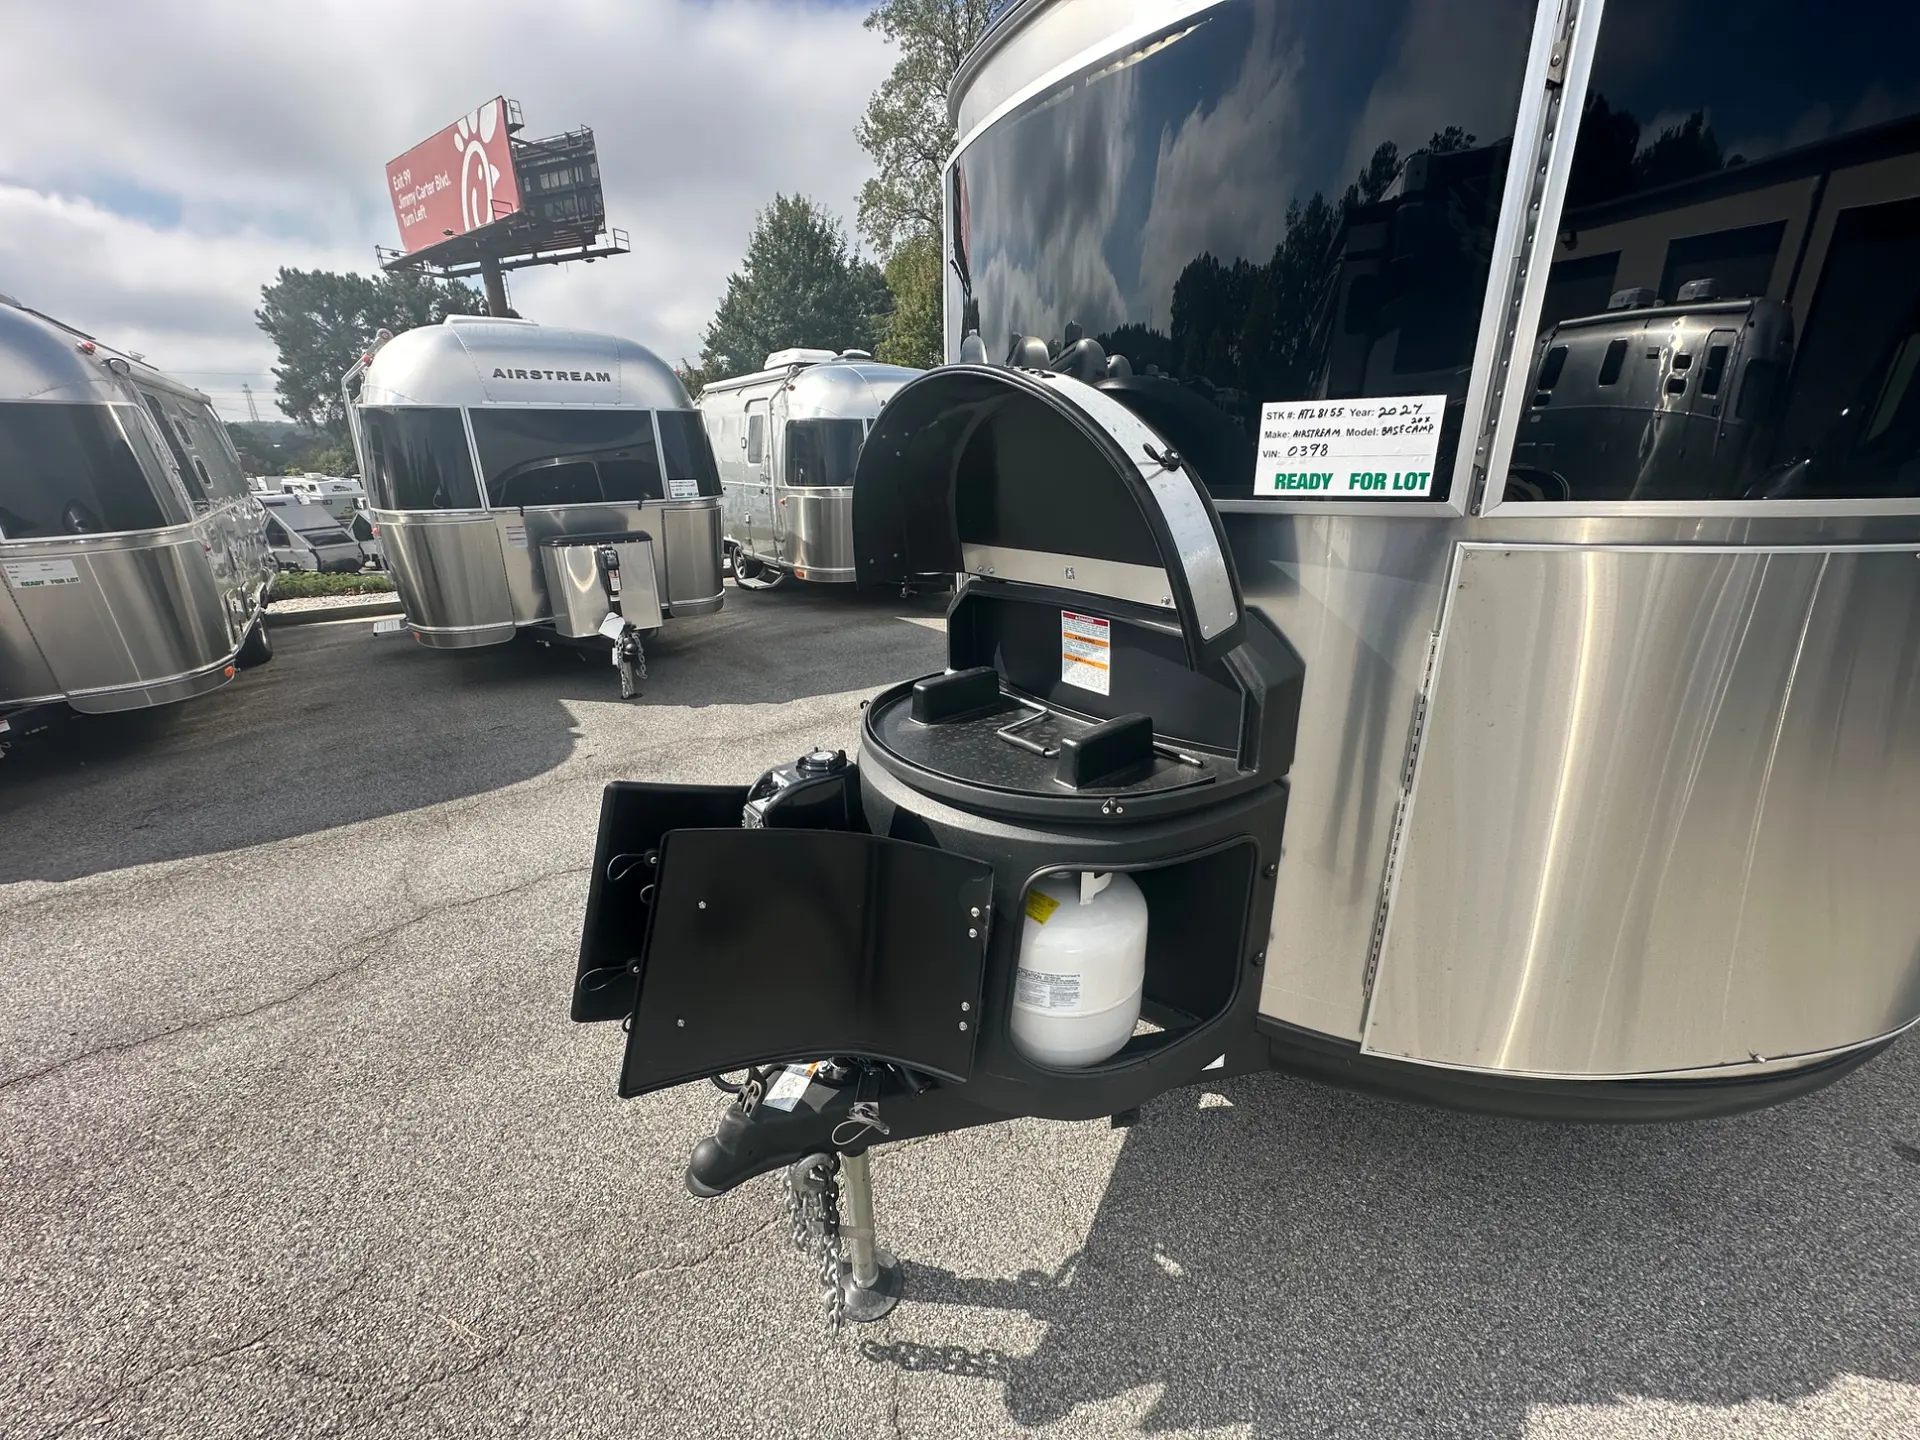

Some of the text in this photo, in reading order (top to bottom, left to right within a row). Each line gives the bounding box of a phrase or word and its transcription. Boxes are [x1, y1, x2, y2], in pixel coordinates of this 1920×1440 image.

[393, 169, 412, 191] Exit 99
[415, 181, 435, 200] Carter
[434, 169, 452, 191] Blvd.
[401, 204, 427, 228] Turn Left
[493, 368, 611, 382] AIRSTREAM
[1266, 411, 1285, 420] STK
[1287, 411, 1296, 420] #:
[1350, 408, 1375, 417] Year:
[1378, 403, 1423, 419] 2027
[1264, 423, 1434, 439] Make: AIRSTREAM Model: BASECAMP
[1262, 443, 1329, 459] VIN: 0398
[1274, 471, 1431, 490] READY FOR LOT
